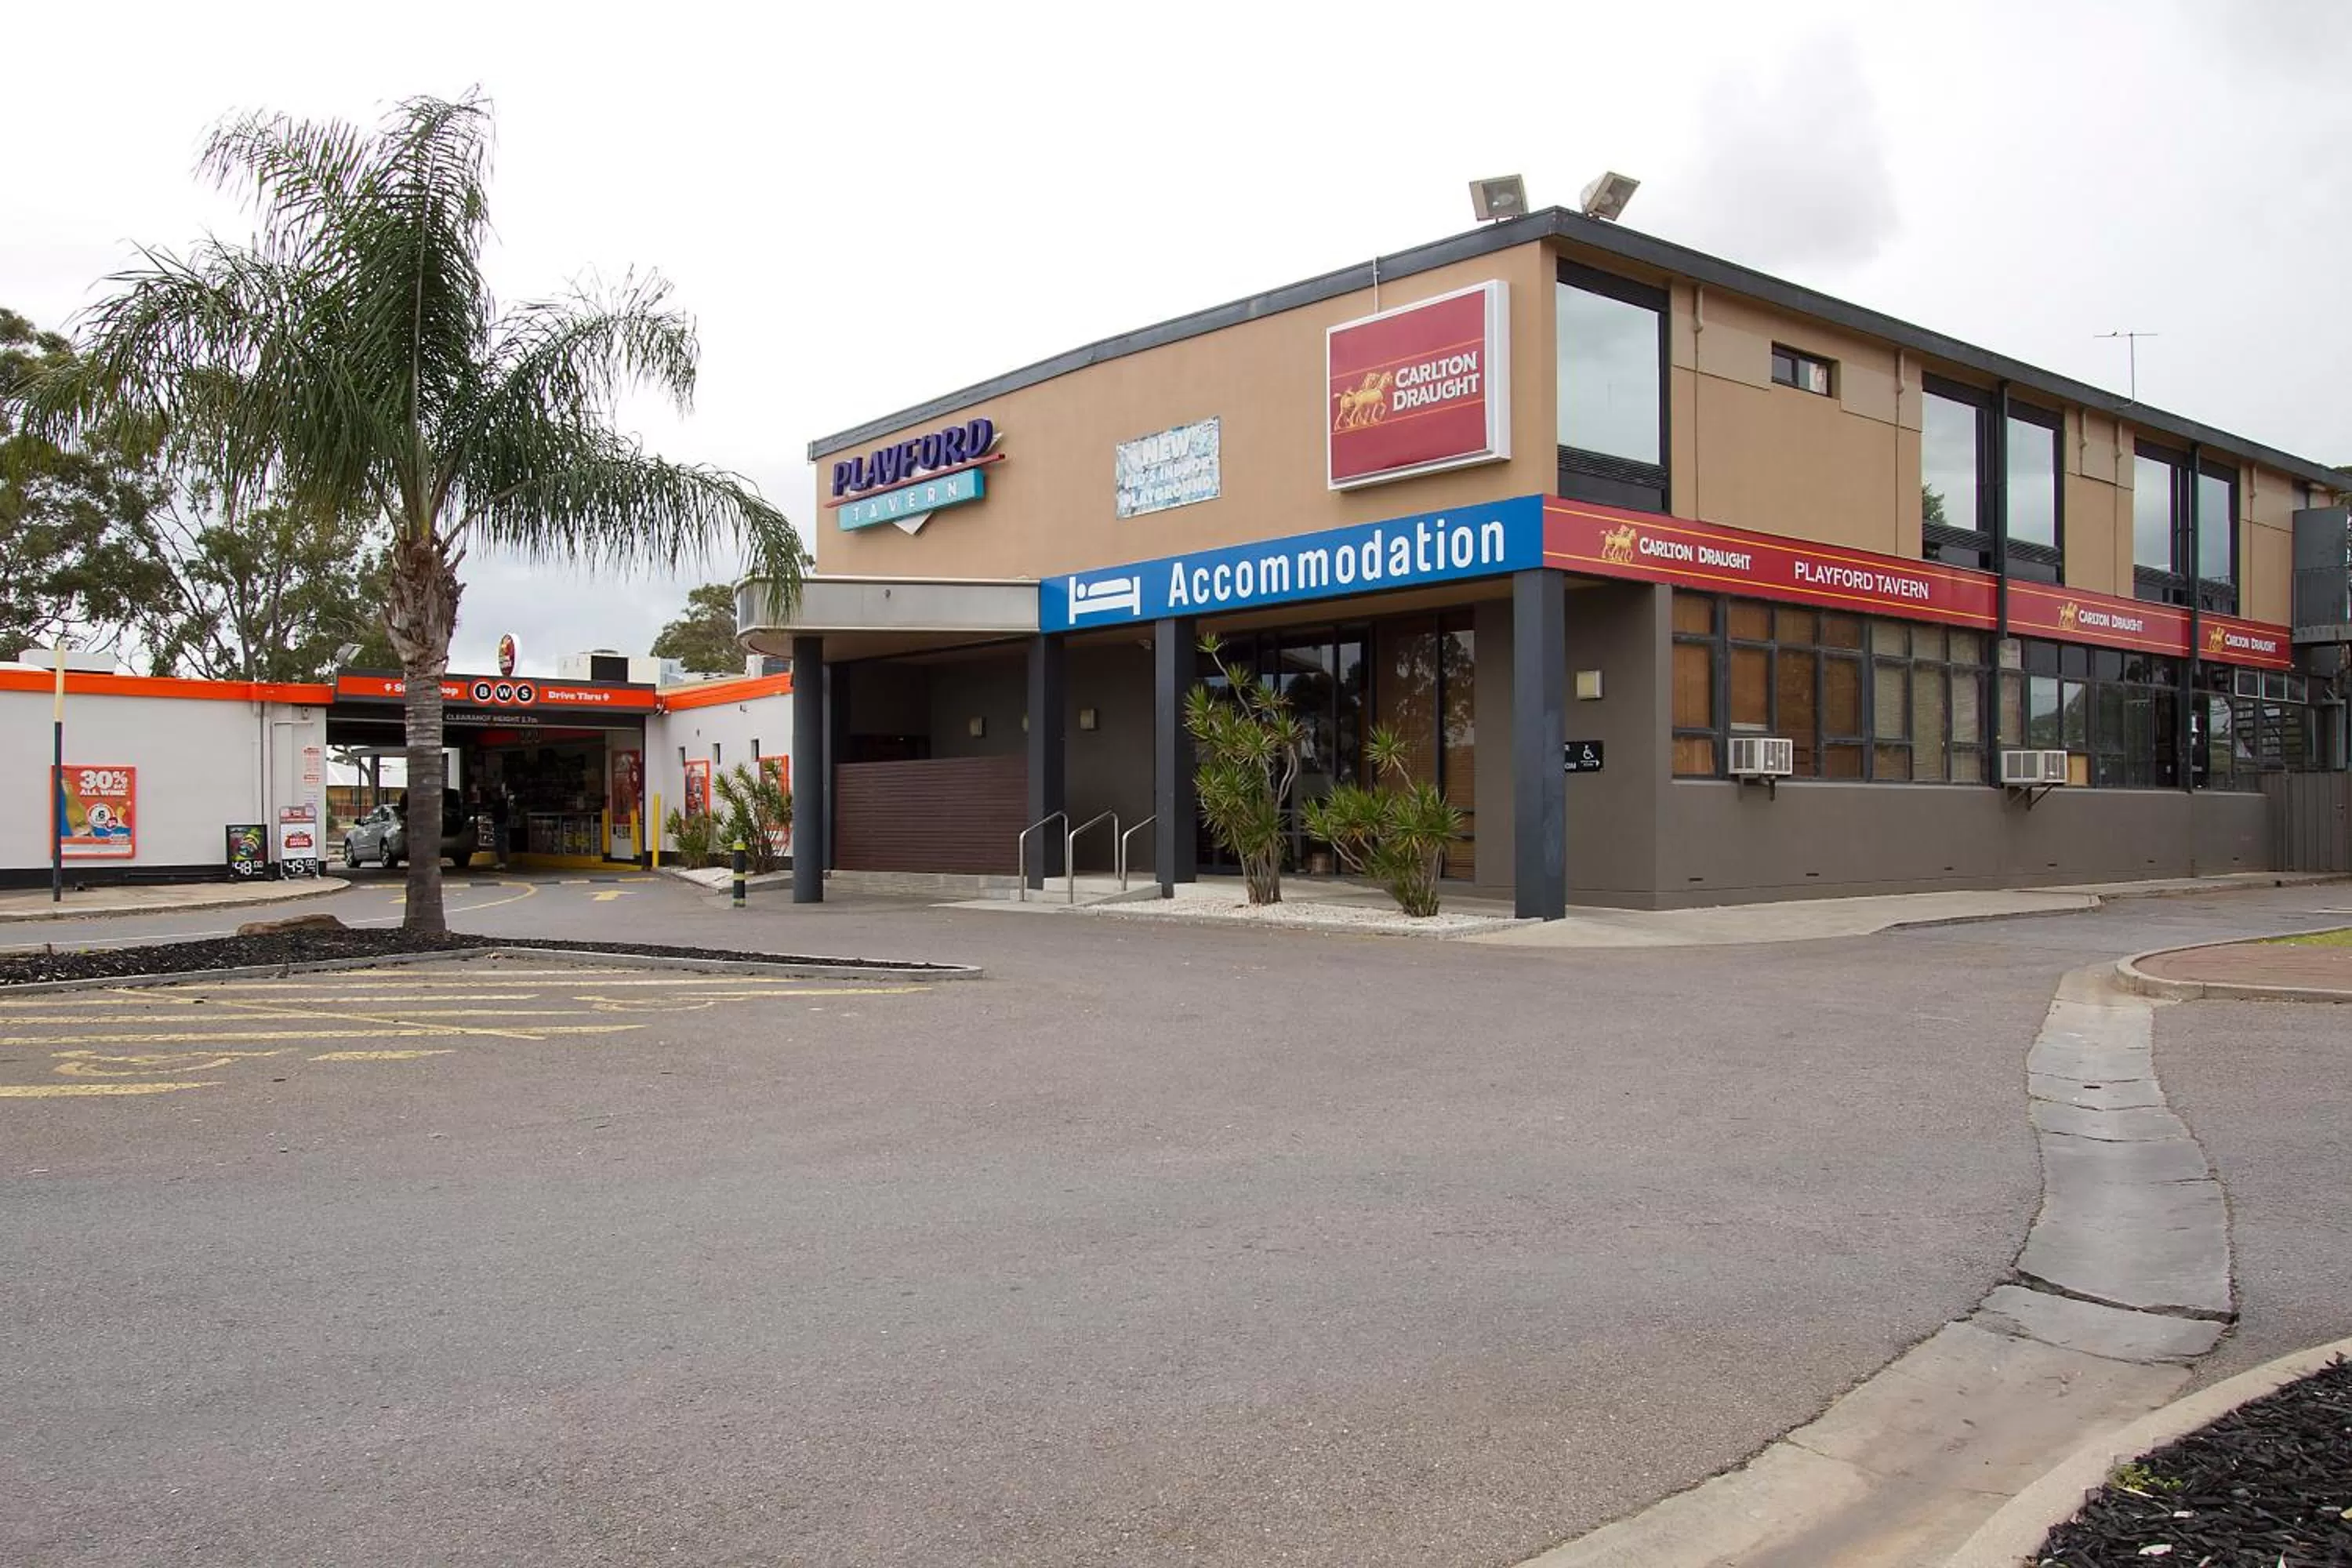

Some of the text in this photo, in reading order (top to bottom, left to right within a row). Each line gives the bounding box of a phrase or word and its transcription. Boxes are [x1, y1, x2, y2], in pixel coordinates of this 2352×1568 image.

[1396, 350, 1478, 388] CARLTON
[1392, 372, 1481, 412] DRAUGHT
[832, 418, 994, 496] PLAYFORD
[1142, 433, 1192, 466] NEW
[853, 480, 958, 521] TAVERN
[1167, 518, 1505, 608] Accommodation
[1639, 536, 1929, 600] CARLTON DRAUGHT PLAYFORD TAVERN
[2078, 609, 2143, 632] CARLTON DRAUGHT
[2251, 637, 2277, 653] DRAUGHT
[548, 691, 602, 701] Drive Thru
[79, 769, 128, 789] 30%
